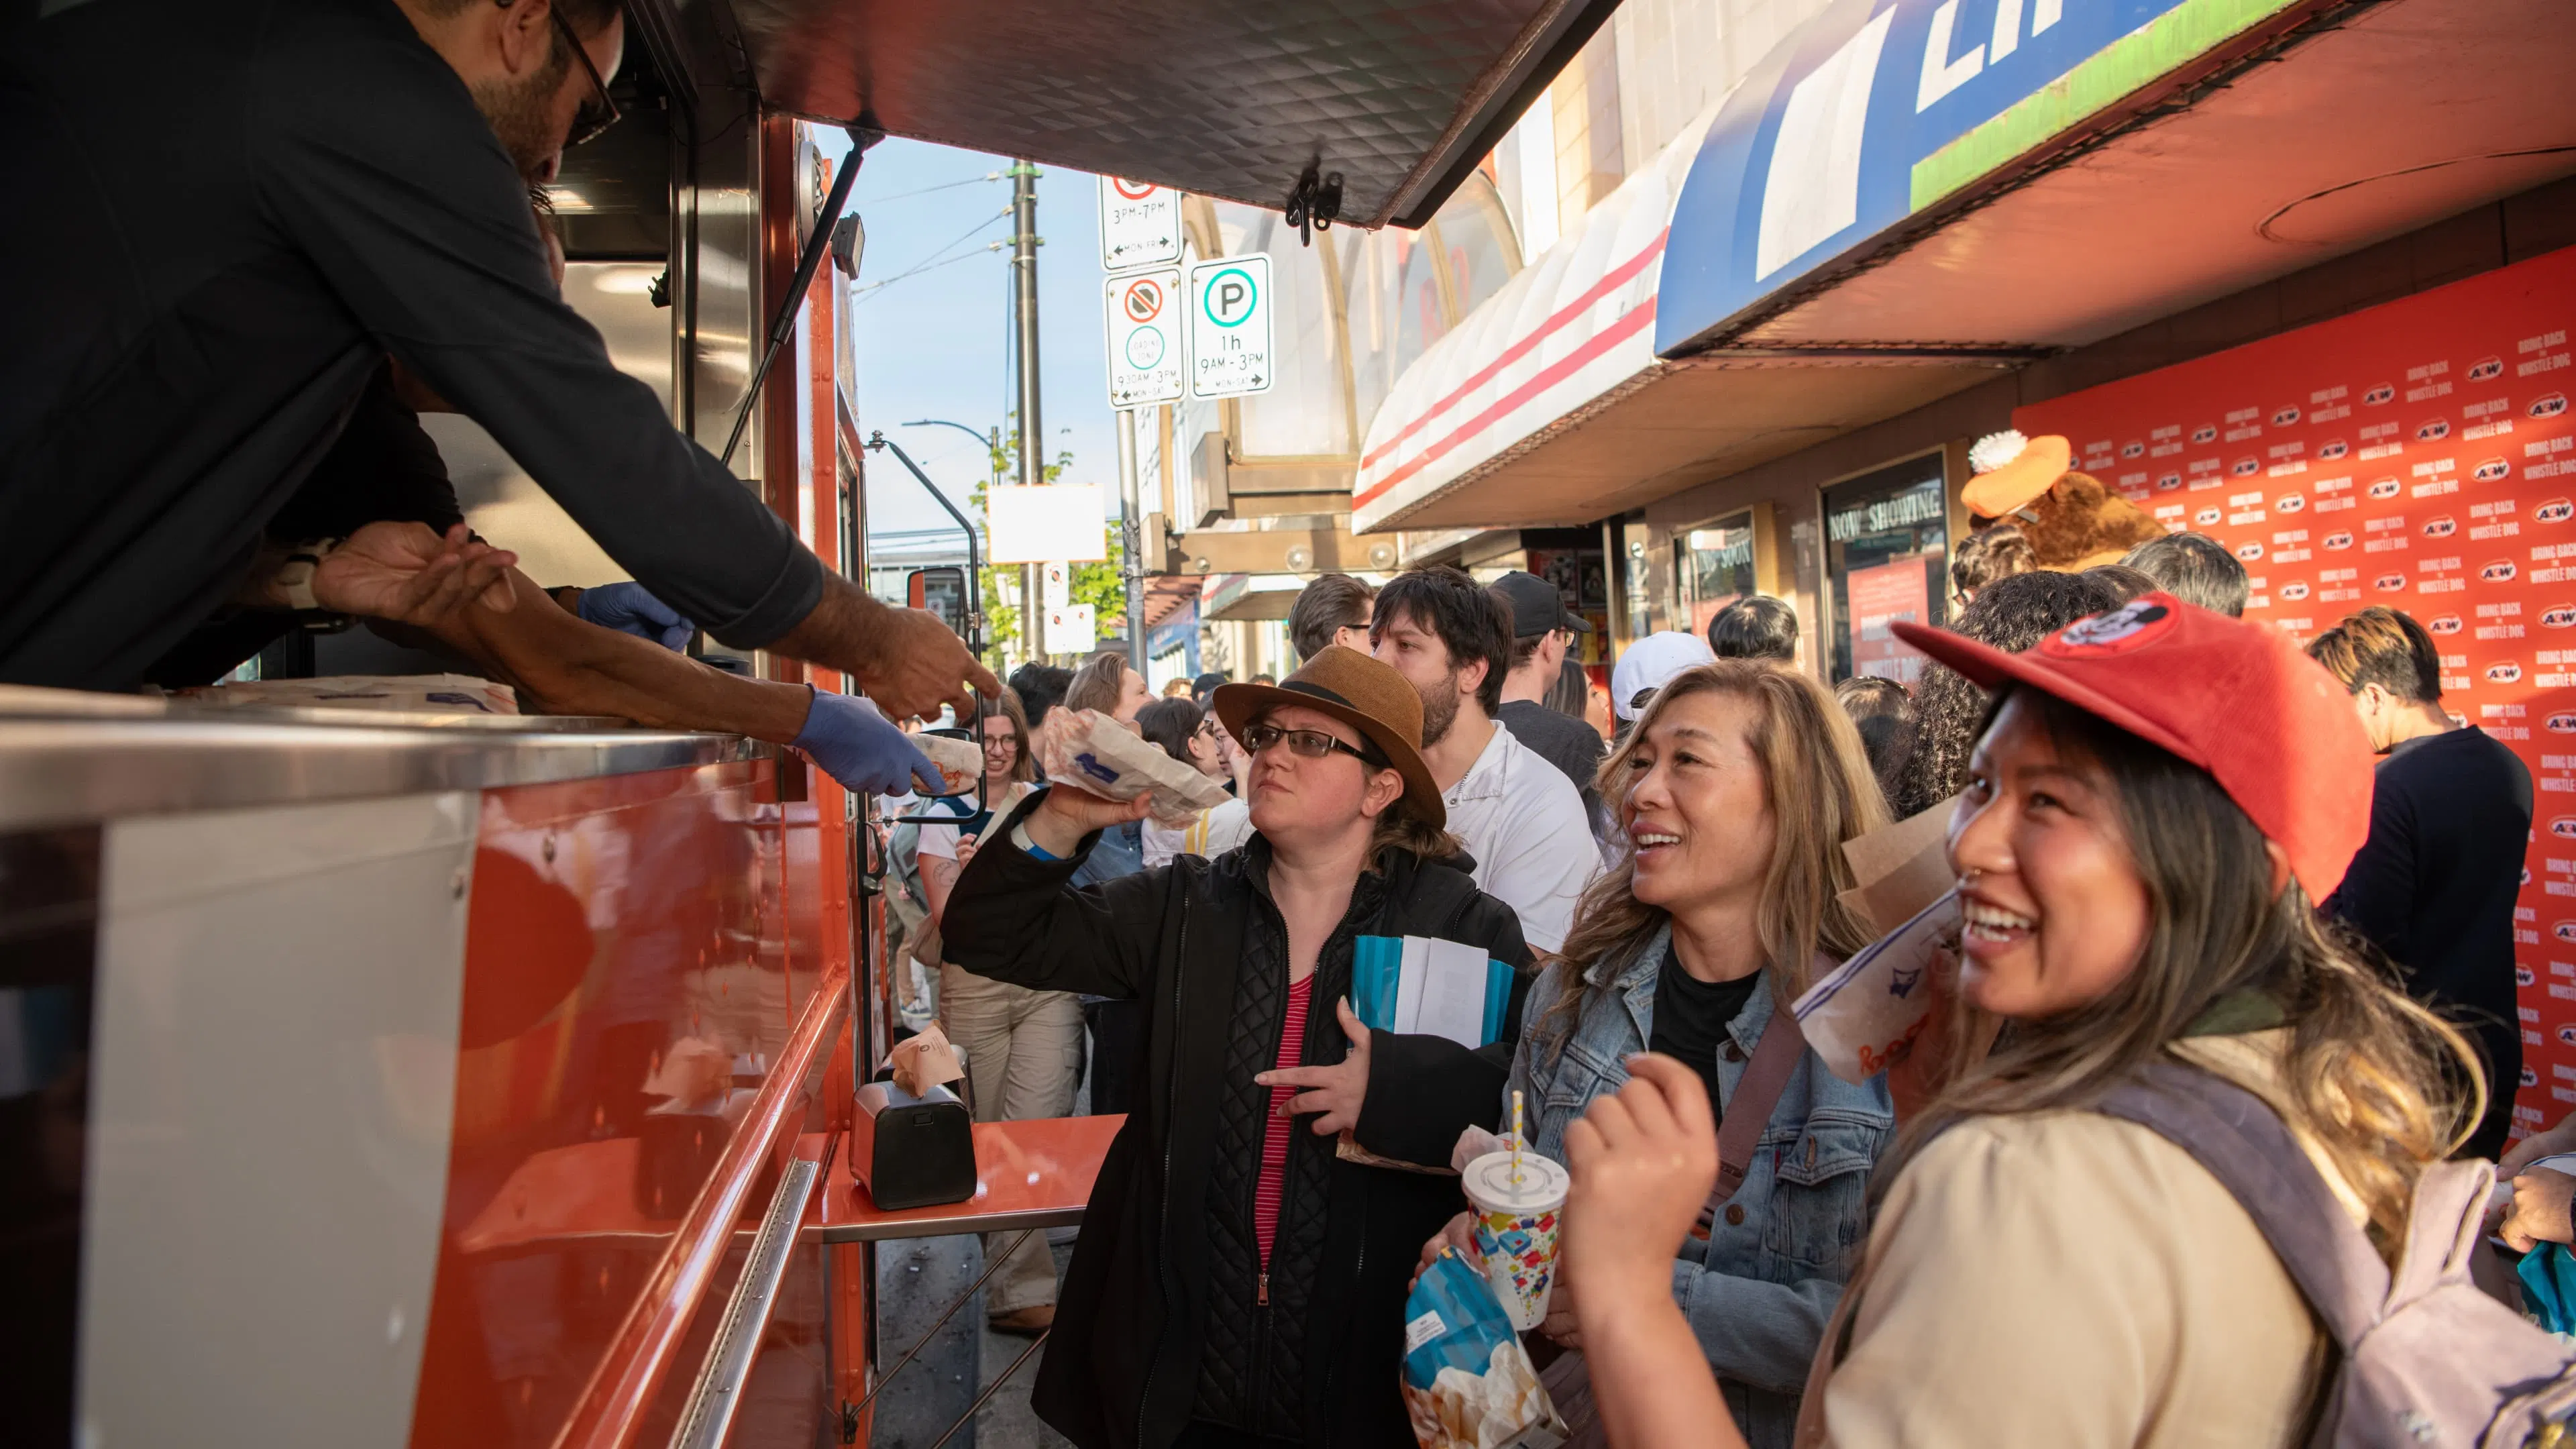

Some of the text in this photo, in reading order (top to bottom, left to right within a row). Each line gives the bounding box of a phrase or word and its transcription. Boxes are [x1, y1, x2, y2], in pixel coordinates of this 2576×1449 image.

[1221, 282, 1244, 316] P
[1829, 489, 1943, 541] NOW SHOWING
